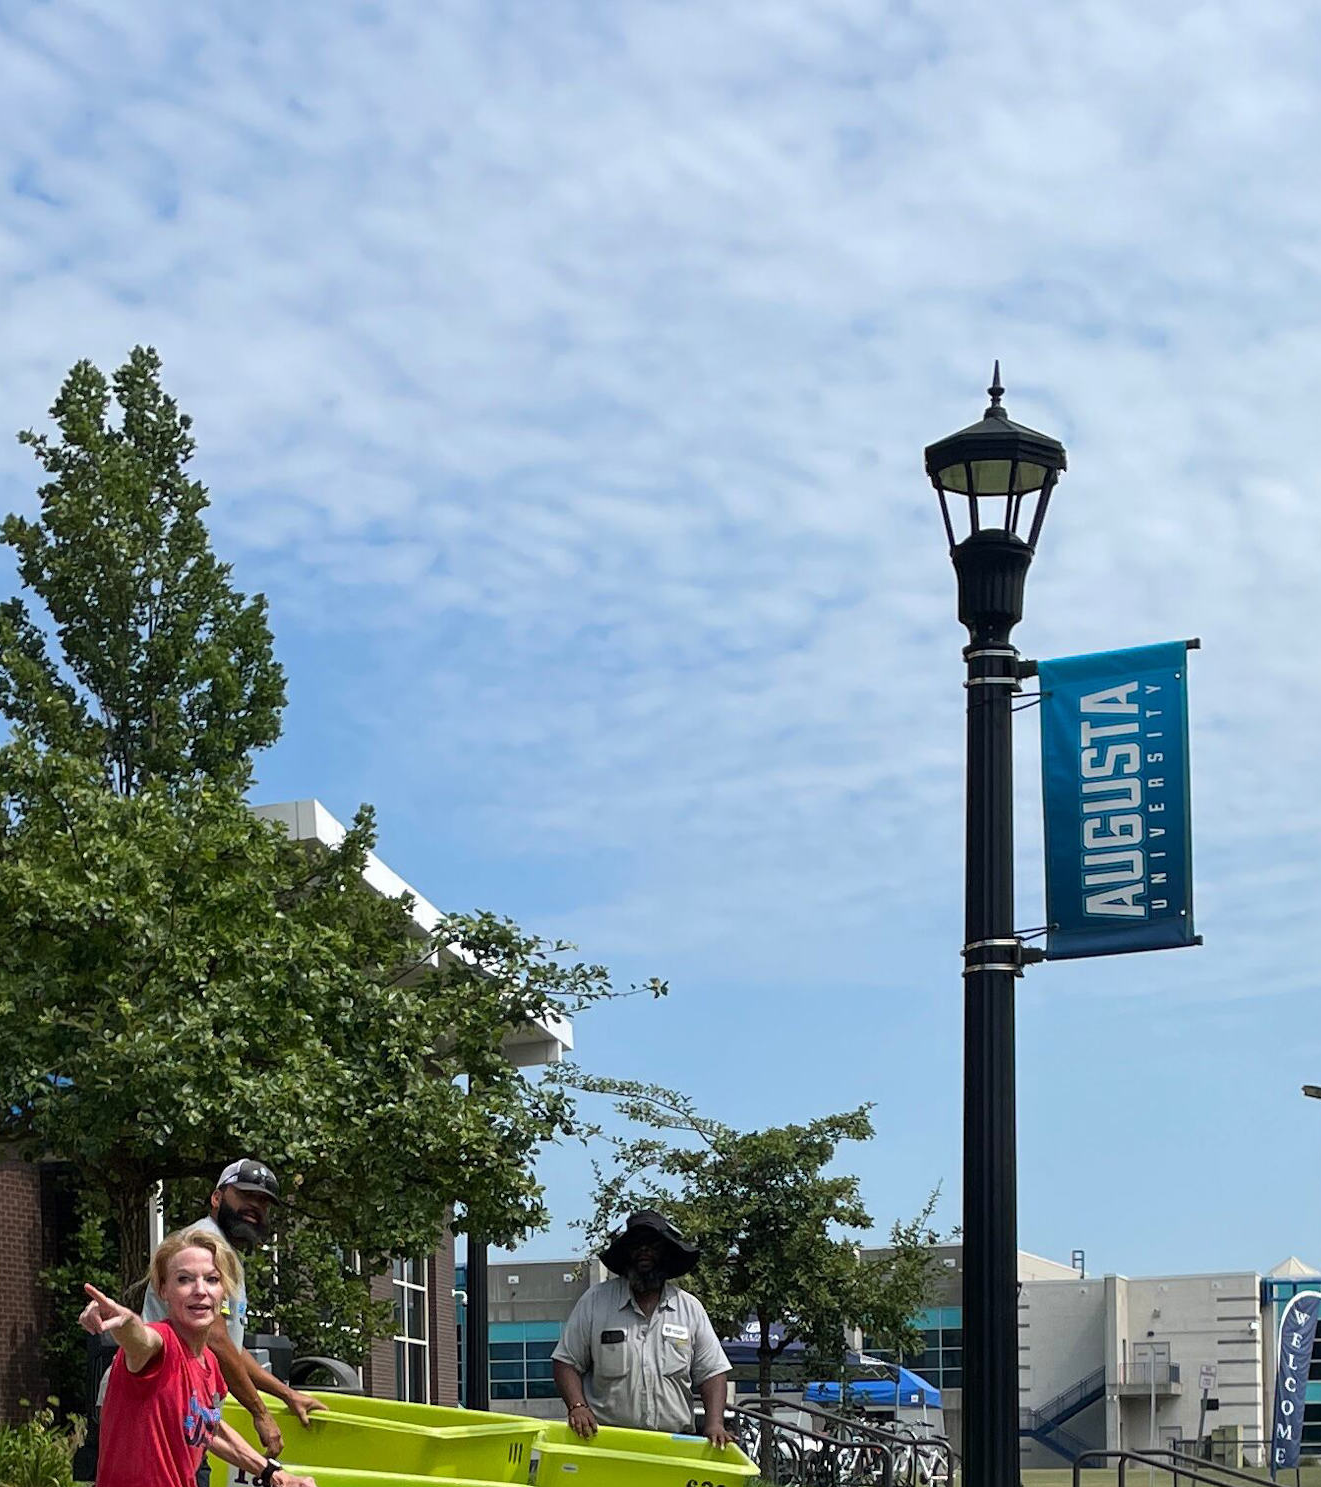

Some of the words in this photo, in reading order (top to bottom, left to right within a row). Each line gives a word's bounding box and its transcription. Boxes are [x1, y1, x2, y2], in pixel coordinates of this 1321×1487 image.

[1080, 680, 1146, 918] AUGUSTA
[1145, 684, 1168, 910] UNIVERSITY
[1275, 1308, 1311, 1465] WELCOME
